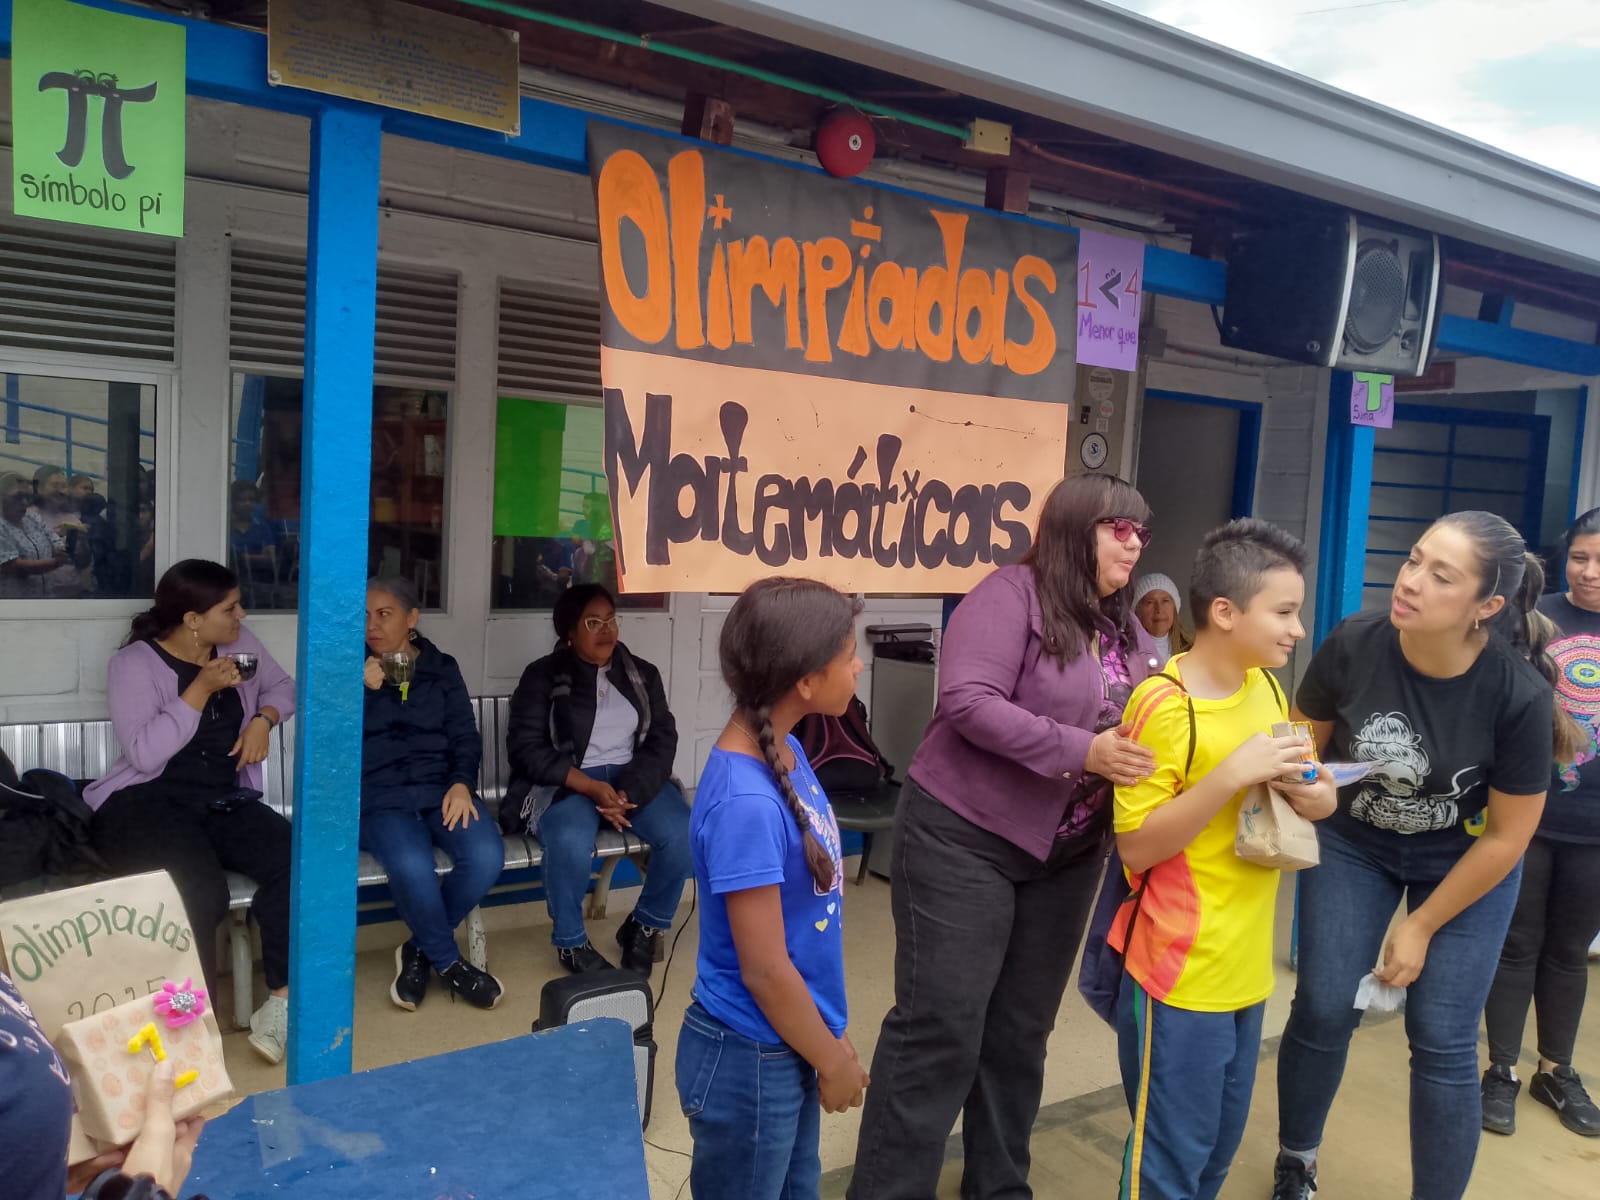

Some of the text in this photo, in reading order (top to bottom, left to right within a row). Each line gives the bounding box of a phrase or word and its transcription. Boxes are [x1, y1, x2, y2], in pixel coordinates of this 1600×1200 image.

[139, 192, 163, 228] pi
[598, 149, 1057, 376] Olimpiadas
[1079, 312, 1137, 353] Menor que
[602, 387, 1033, 574] Matemáticas
